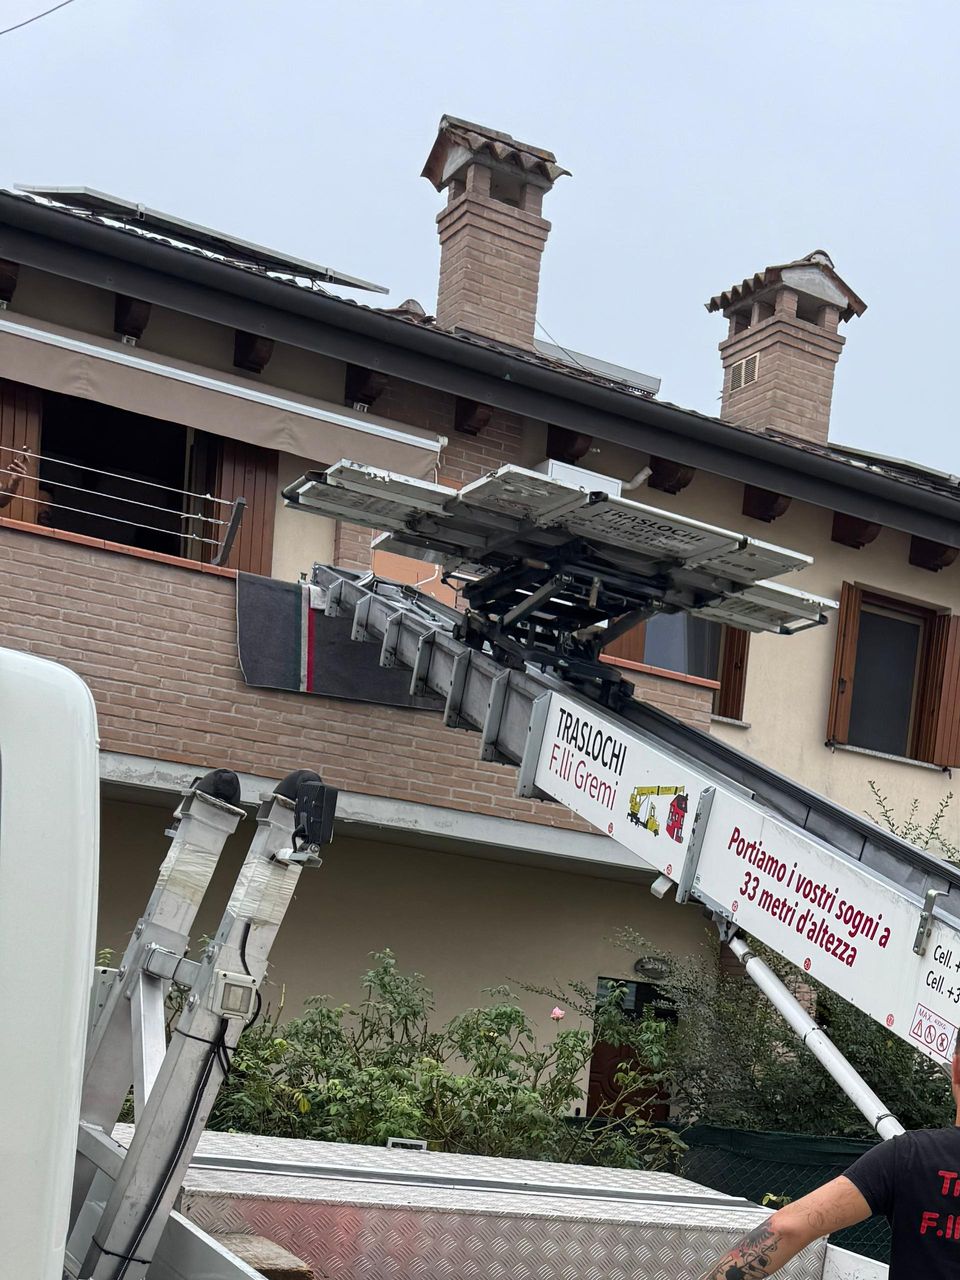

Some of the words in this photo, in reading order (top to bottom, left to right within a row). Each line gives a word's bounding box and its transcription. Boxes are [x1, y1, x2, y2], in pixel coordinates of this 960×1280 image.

[604, 508, 706, 542] TRASLOCHI
[556, 708, 628, 776] TRASLOCHI
[549, 743, 575, 782] F.lli
[574, 760, 619, 811] Gremi
[727, 826, 787, 883] Portiamo
[786, 862, 798, 888] i
[795, 873, 839, 914] vostri
[835, 899, 882, 941] sogni
[878, 926, 891, 949] a
[739, 871, 760, 902] 33
[757, 888, 799, 927] metri
[795, 908, 858, 968] d'altezza
[926, 970, 945, 995] Cell.
[933, 945, 953, 969] Cell.
